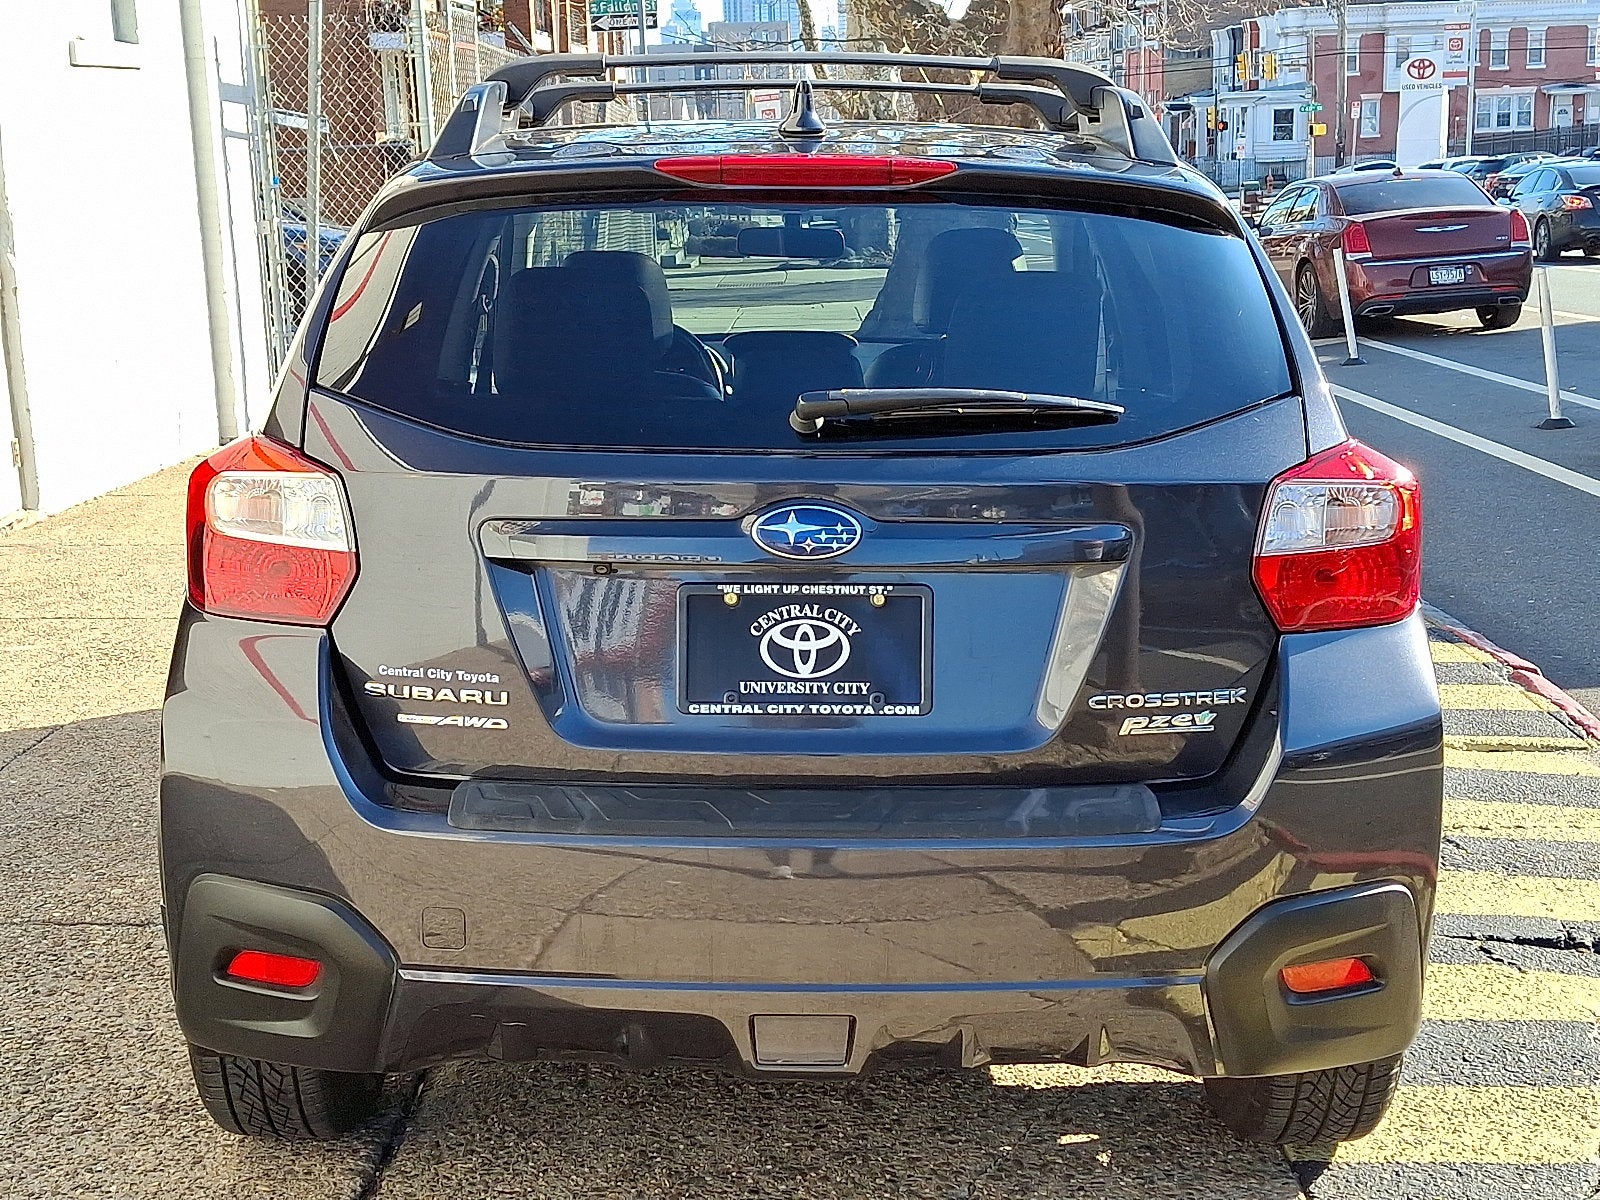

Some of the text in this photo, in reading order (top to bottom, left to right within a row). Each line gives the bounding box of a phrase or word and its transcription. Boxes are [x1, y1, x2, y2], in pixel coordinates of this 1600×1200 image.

[743, 585, 780, 594] LIGHT
[782, 585, 799, 594] UP
[801, 585, 867, 595] CHESTNUT
[750, 604, 863, 637] CENTRAL CITY
[378, 665, 500, 684] Central City Toyota
[364, 681, 510, 706] SUBARU
[739, 681, 871, 695] UNIVERSITY CITY
[1088, 687, 1248, 710] CROSSTREK
[688, 704, 920, 715] CENTRAL CITY TOYOTA .COM
[437, 715, 509, 730] AWD
